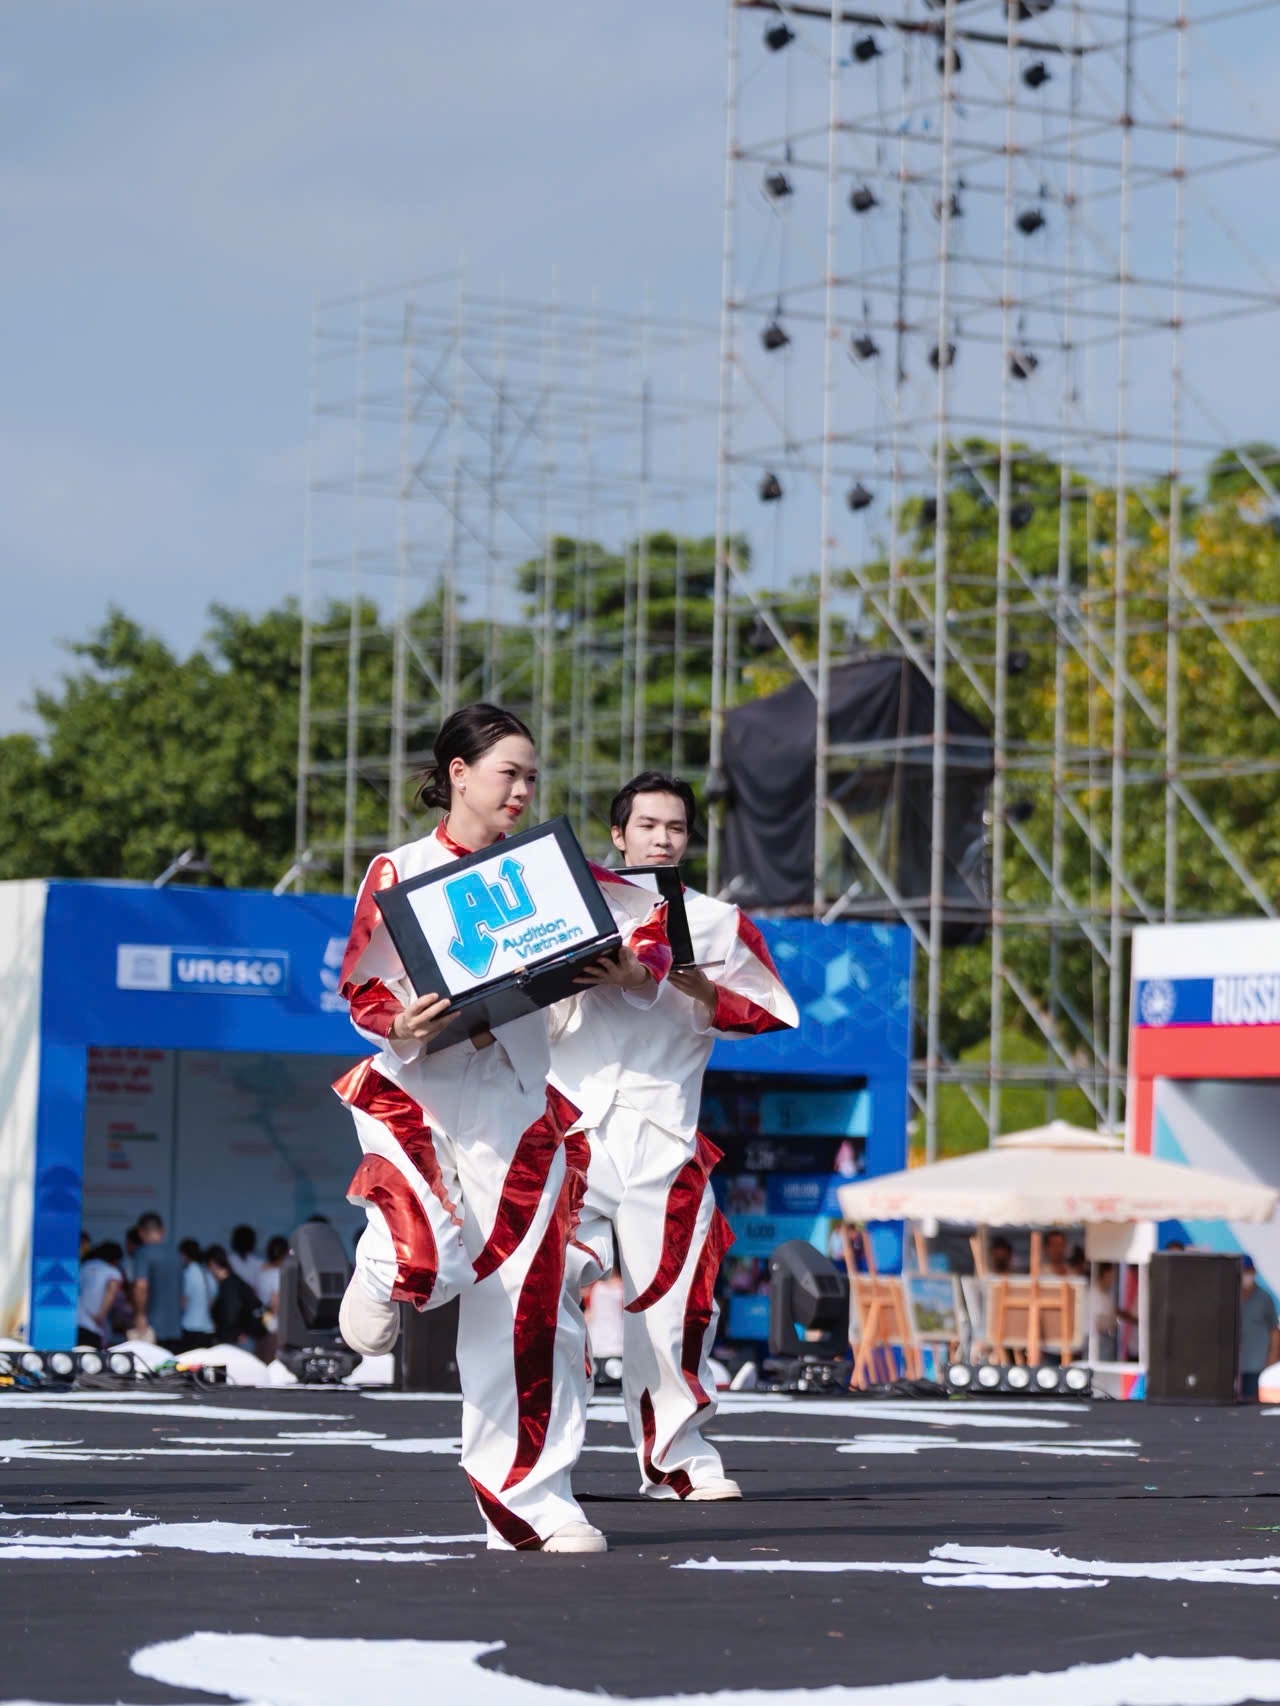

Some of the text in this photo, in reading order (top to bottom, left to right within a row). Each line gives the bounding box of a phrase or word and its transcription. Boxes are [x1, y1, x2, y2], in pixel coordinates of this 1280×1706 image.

[502, 918, 567, 952] Audition
[515, 926, 583, 959] Vietnam
[177, 957, 282, 986] unesco
